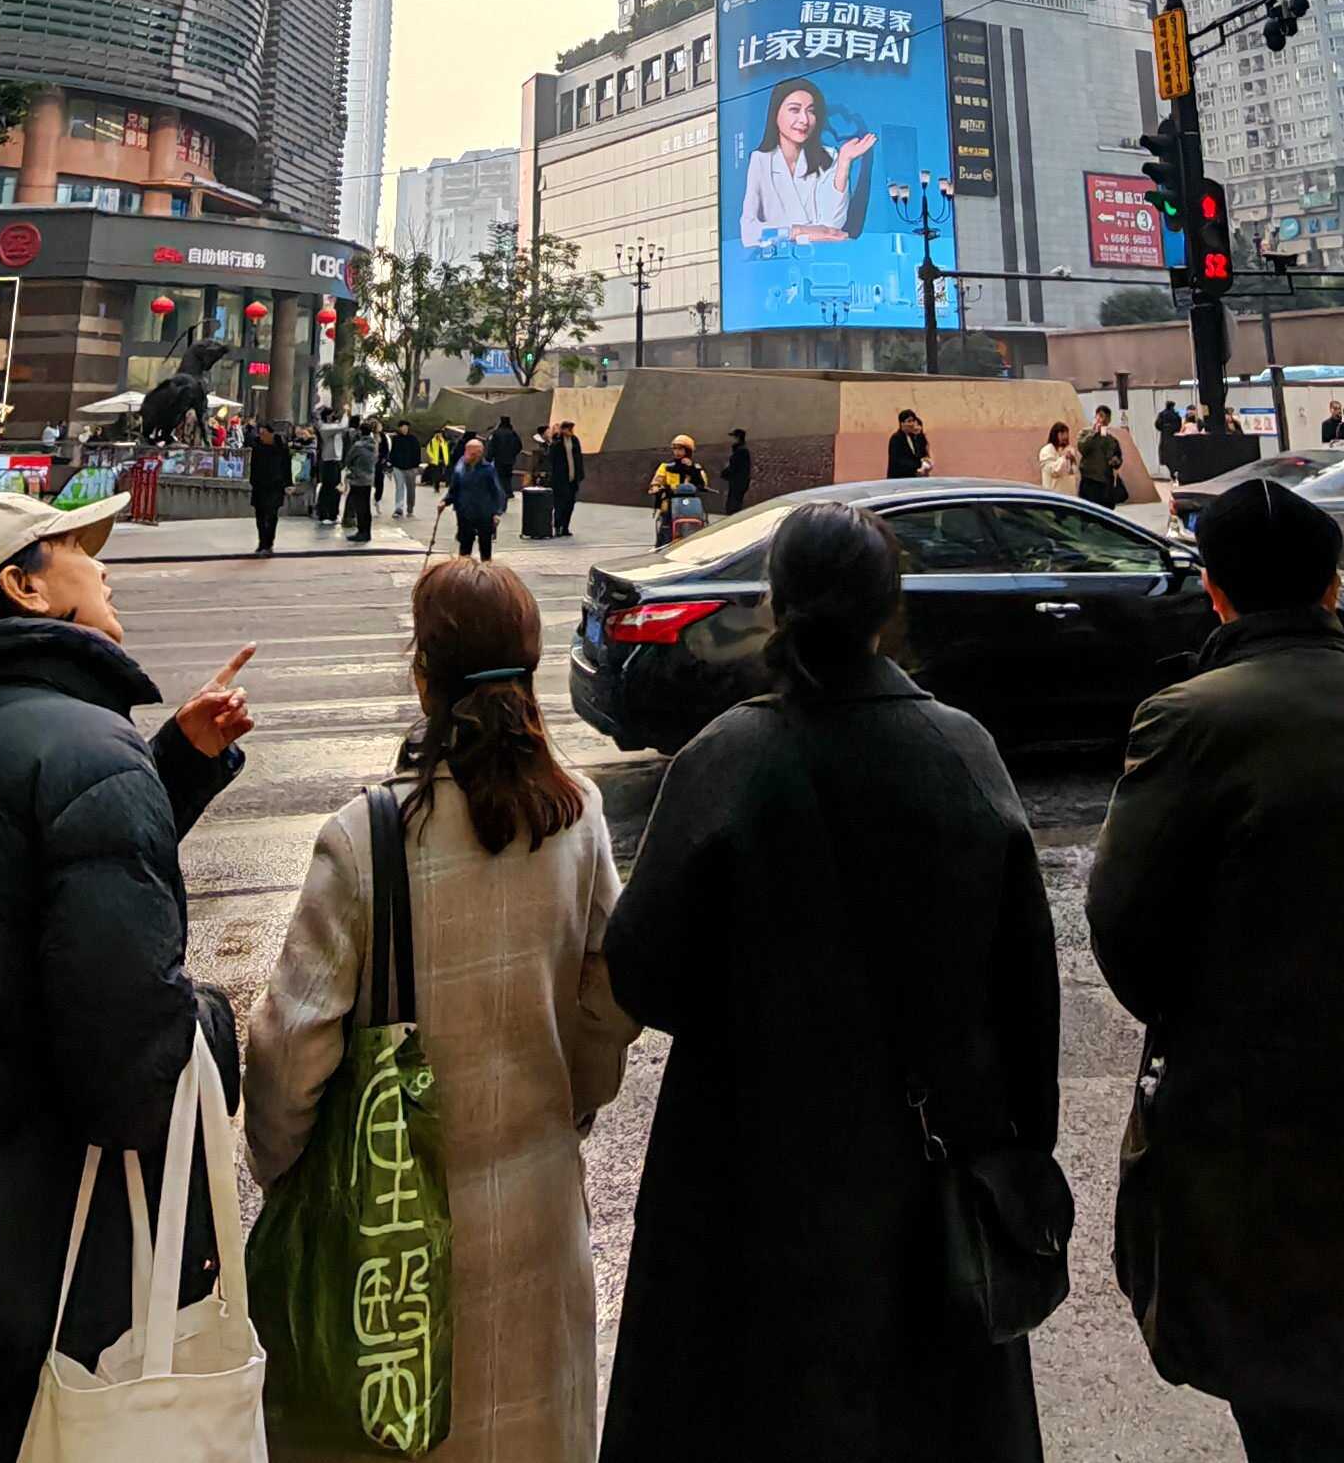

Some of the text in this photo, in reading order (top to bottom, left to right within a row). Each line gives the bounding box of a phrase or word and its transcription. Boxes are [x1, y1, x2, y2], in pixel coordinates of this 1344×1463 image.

[800, 0, 913, 33] 移动爱家
[737, 27, 910, 69] 让家更有AI
[187, 248, 267, 269] 自助银行服务
[310, 252, 345, 280] ICBC
